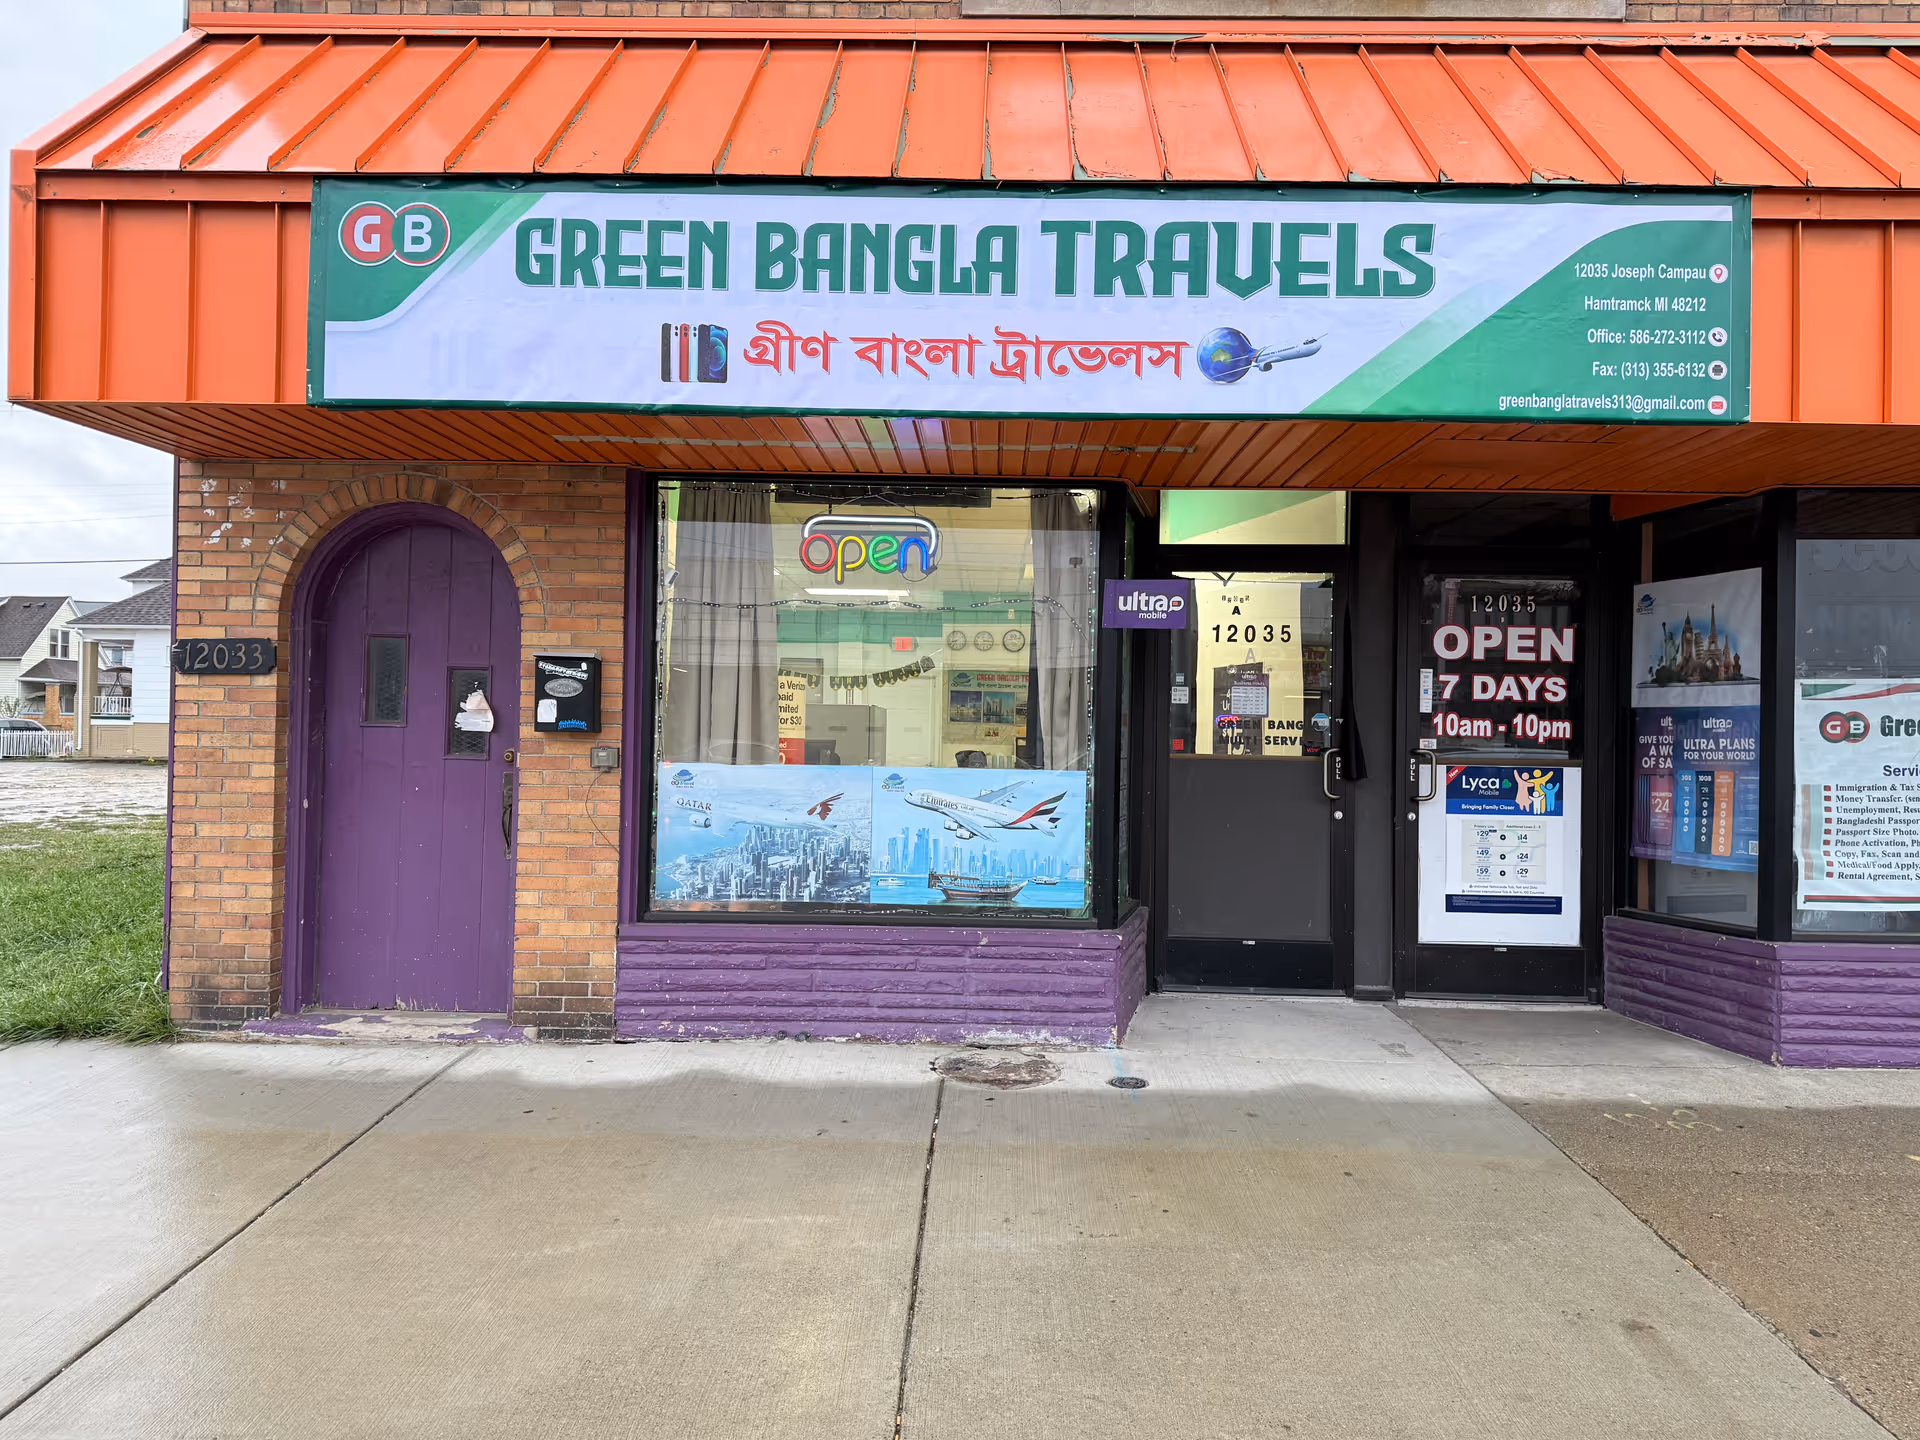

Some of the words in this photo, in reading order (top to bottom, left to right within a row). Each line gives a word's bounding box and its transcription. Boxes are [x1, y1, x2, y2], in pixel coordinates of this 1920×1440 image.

[515, 217, 729, 291] GREEN
[754, 221, 1019, 295] BANGLA
[1040, 219, 1436, 300] TRAVELS
[1574, 263, 1608, 278] 12035
[1611, 263, 1655, 282] Joseph
[1658, 264, 1706, 282] Campau
[1584, 296, 1651, 312] Hamtramck
[1654, 297, 1668, 312] MI
[1671, 297, 1706, 312] 48212
[1587, 328, 1626, 344] Office:
[1629, 329, 1706, 345] 586-272-3112
[743, 319, 839, 376] গ্রীণ
[849, 331, 985, 380] বাংলা
[989, 325, 1192, 384] ট্রাভেলস
[1592, 362, 1618, 377] Fax:
[1621, 362, 1650, 380] (313)
[1653, 363, 1706, 378] 355-6132
[1499, 394, 1705, 413] greenbanglatravels313@gmail.com
[800, 532, 930, 584] open
[1118, 591, 1169, 612] ultra
[1472, 595, 1535, 613] 12035
[1139, 611, 1167, 620] mobile
[1231, 605, 1241, 616] A
[1212, 624, 1291, 643] 12035
[1433, 623, 1575, 663] OPEN
[183, 642, 263, 670] 12033
[1437, 673, 1461, 701] 7
[1471, 673, 1567, 703] DAYS
[1432, 711, 1494, 738] 10am
[1512, 712, 1573, 745] 10pm
[1826, 720, 1865, 734] GB
[1880, 715, 1920, 737] Gre
[1639, 735, 1657, 744] GIVE
[1683, 739, 1716, 750] ULTRA
[1719, 739, 1756, 750] PLANS
[1649, 745, 1657, 756] A
[1684, 751, 1699, 760] FOR
[1701, 751, 1724, 760] YOUR
[1726, 751, 1756, 760] WORLD
[1642, 757, 1656, 769] OF
[1883, 764, 1920, 777] Servi
[1462, 775, 1499, 791] Lyca
[1836, 784, 1887, 793] Immigration
[677, 797, 712, 811] QATAR
[926, 795, 958, 810] Emirates
[1836, 795, 1864, 804] Money
[1866, 795, 1903, 803] Transfer.
[1461, 803, 1482, 811] Bringing
[1836, 806, 1901, 815] Unemployment,
[1836, 817, 1886, 826] Bangladeshi
[1836, 828, 1871, 837] Passport
[1893, 828, 1919, 836] Photo.
[1835, 839, 1860, 847] Phone
[1862, 839, 1908, 848] Activation,
[1835, 850, 1858, 859] Copy,
[1882, 850, 1901, 858] Scan
[1838, 861, 1892, 869] Medical/Food
[1867, 872, 1912, 881] Agreement,
